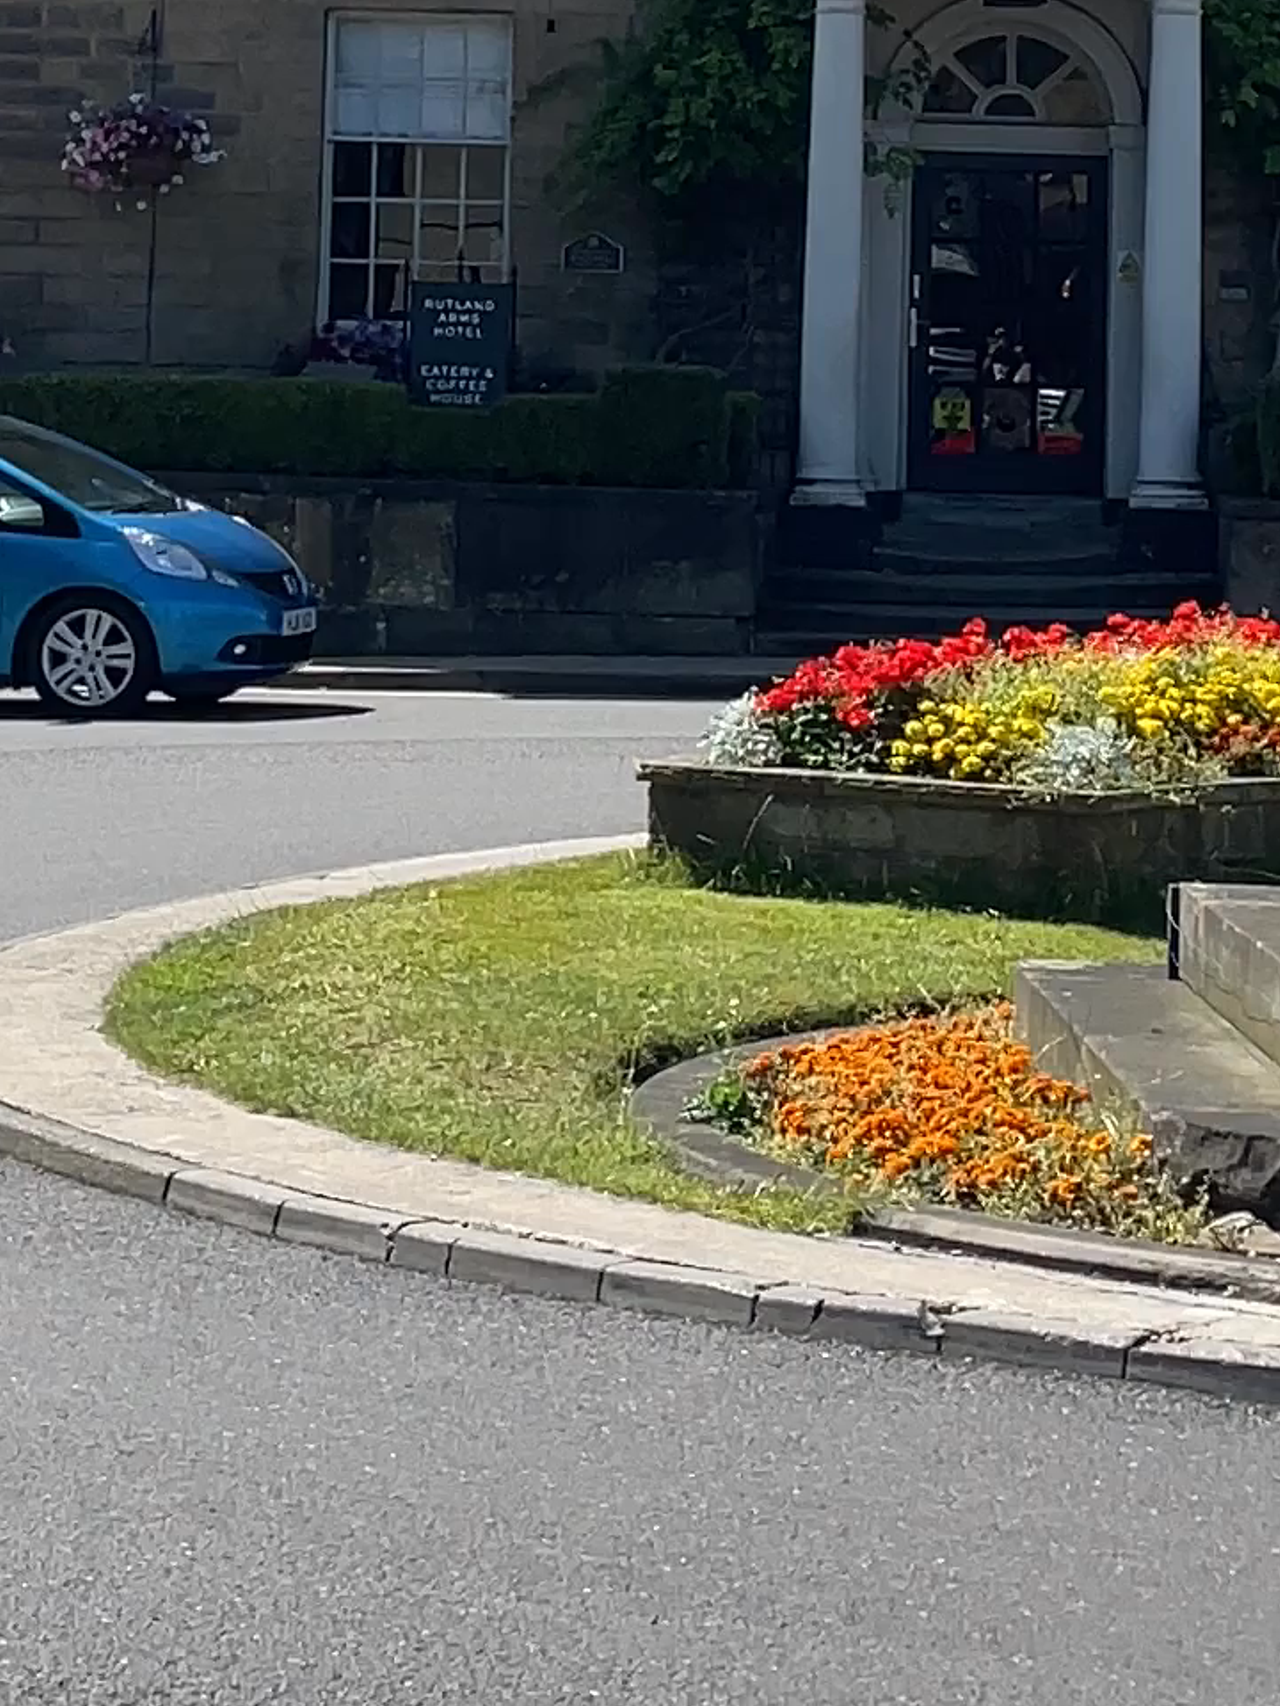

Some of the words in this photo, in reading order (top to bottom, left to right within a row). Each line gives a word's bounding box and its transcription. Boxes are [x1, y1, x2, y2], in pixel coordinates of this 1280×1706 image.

[423, 297, 496, 312] RUTLAND
[437, 311, 481, 325] ARMS
[432, 325, 483, 340] HOTEL
[420, 364, 480, 377] EATERY
[483, 366, 495, 379] &
[424, 378, 487, 392] COFFEE
